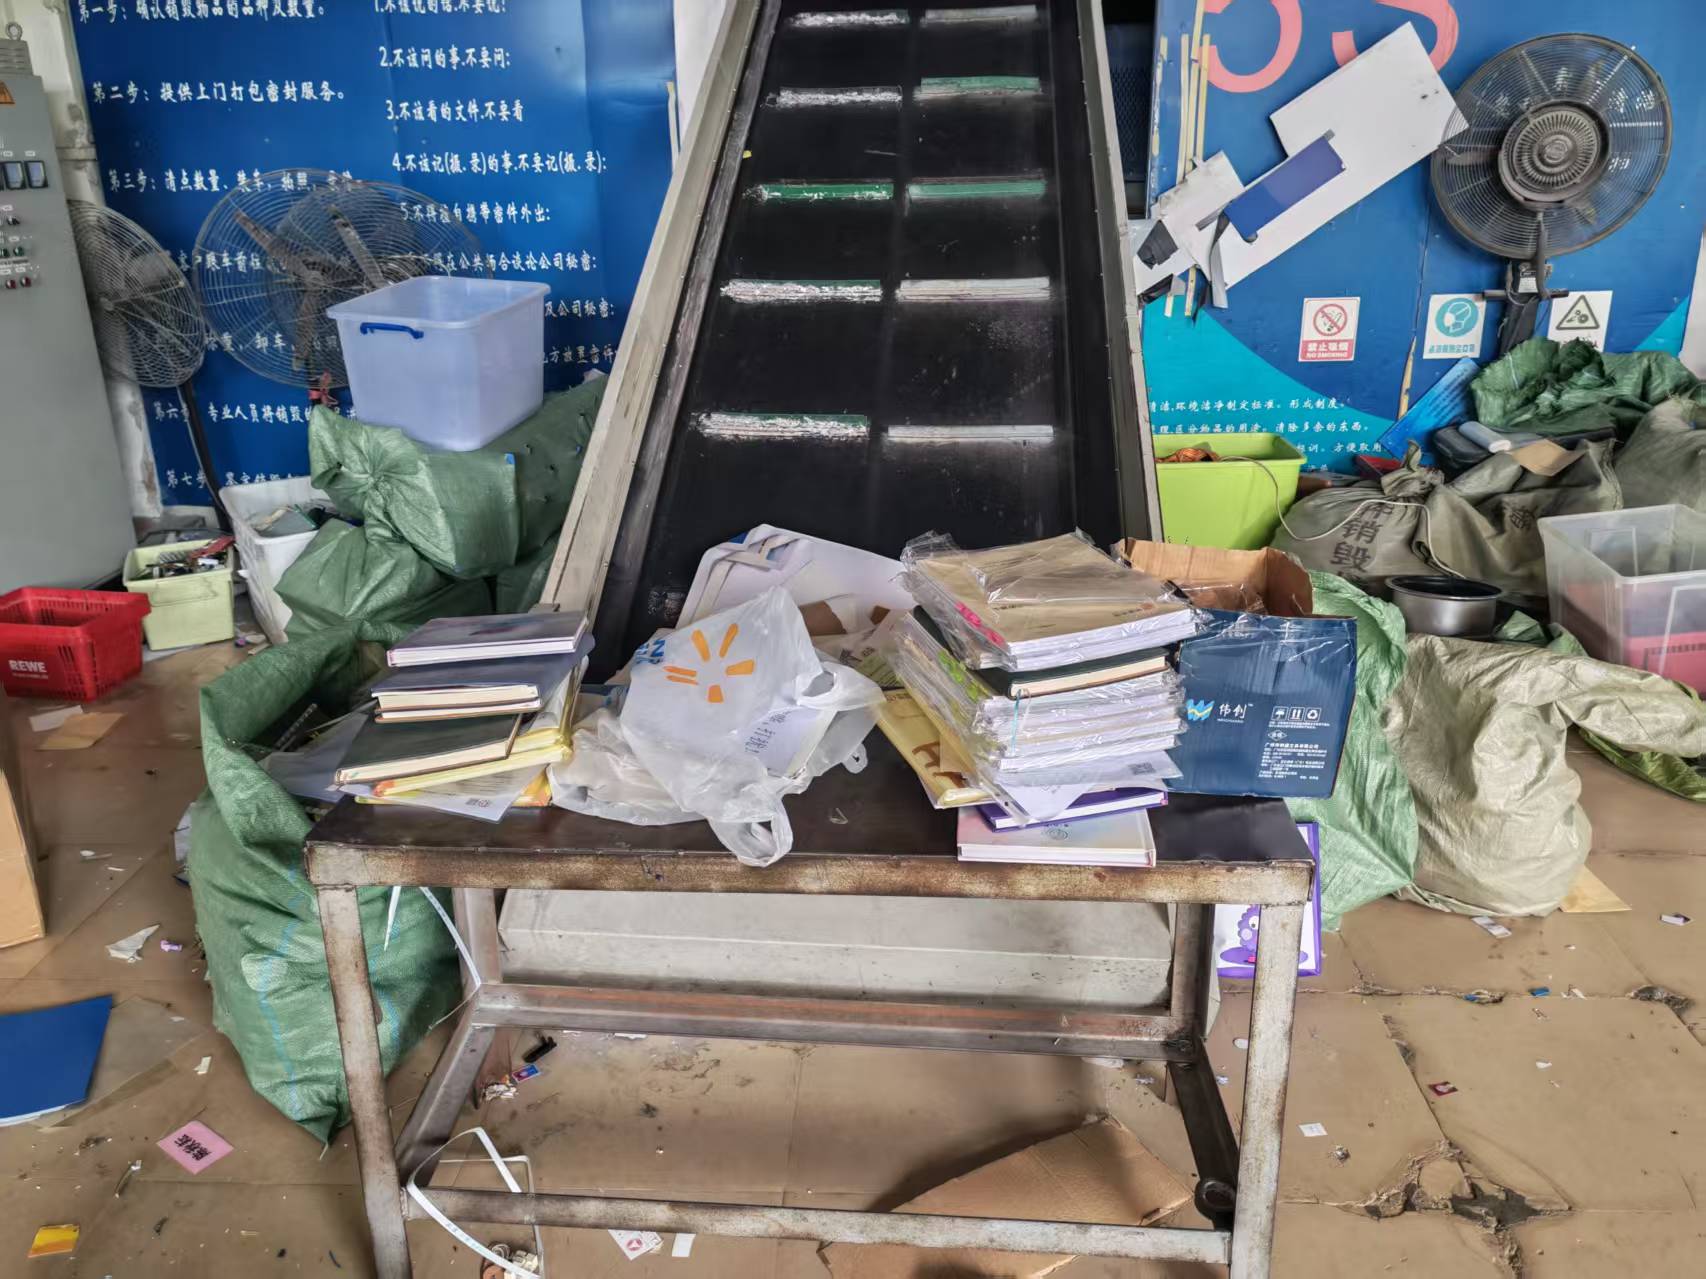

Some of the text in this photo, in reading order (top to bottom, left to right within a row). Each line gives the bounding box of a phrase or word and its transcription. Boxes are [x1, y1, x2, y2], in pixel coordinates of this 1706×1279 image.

[1307, 341, 1349, 352] 禁止吸烟
[8, 660, 47, 672] REWE
[1219, 703, 1247, 719] 伟创
